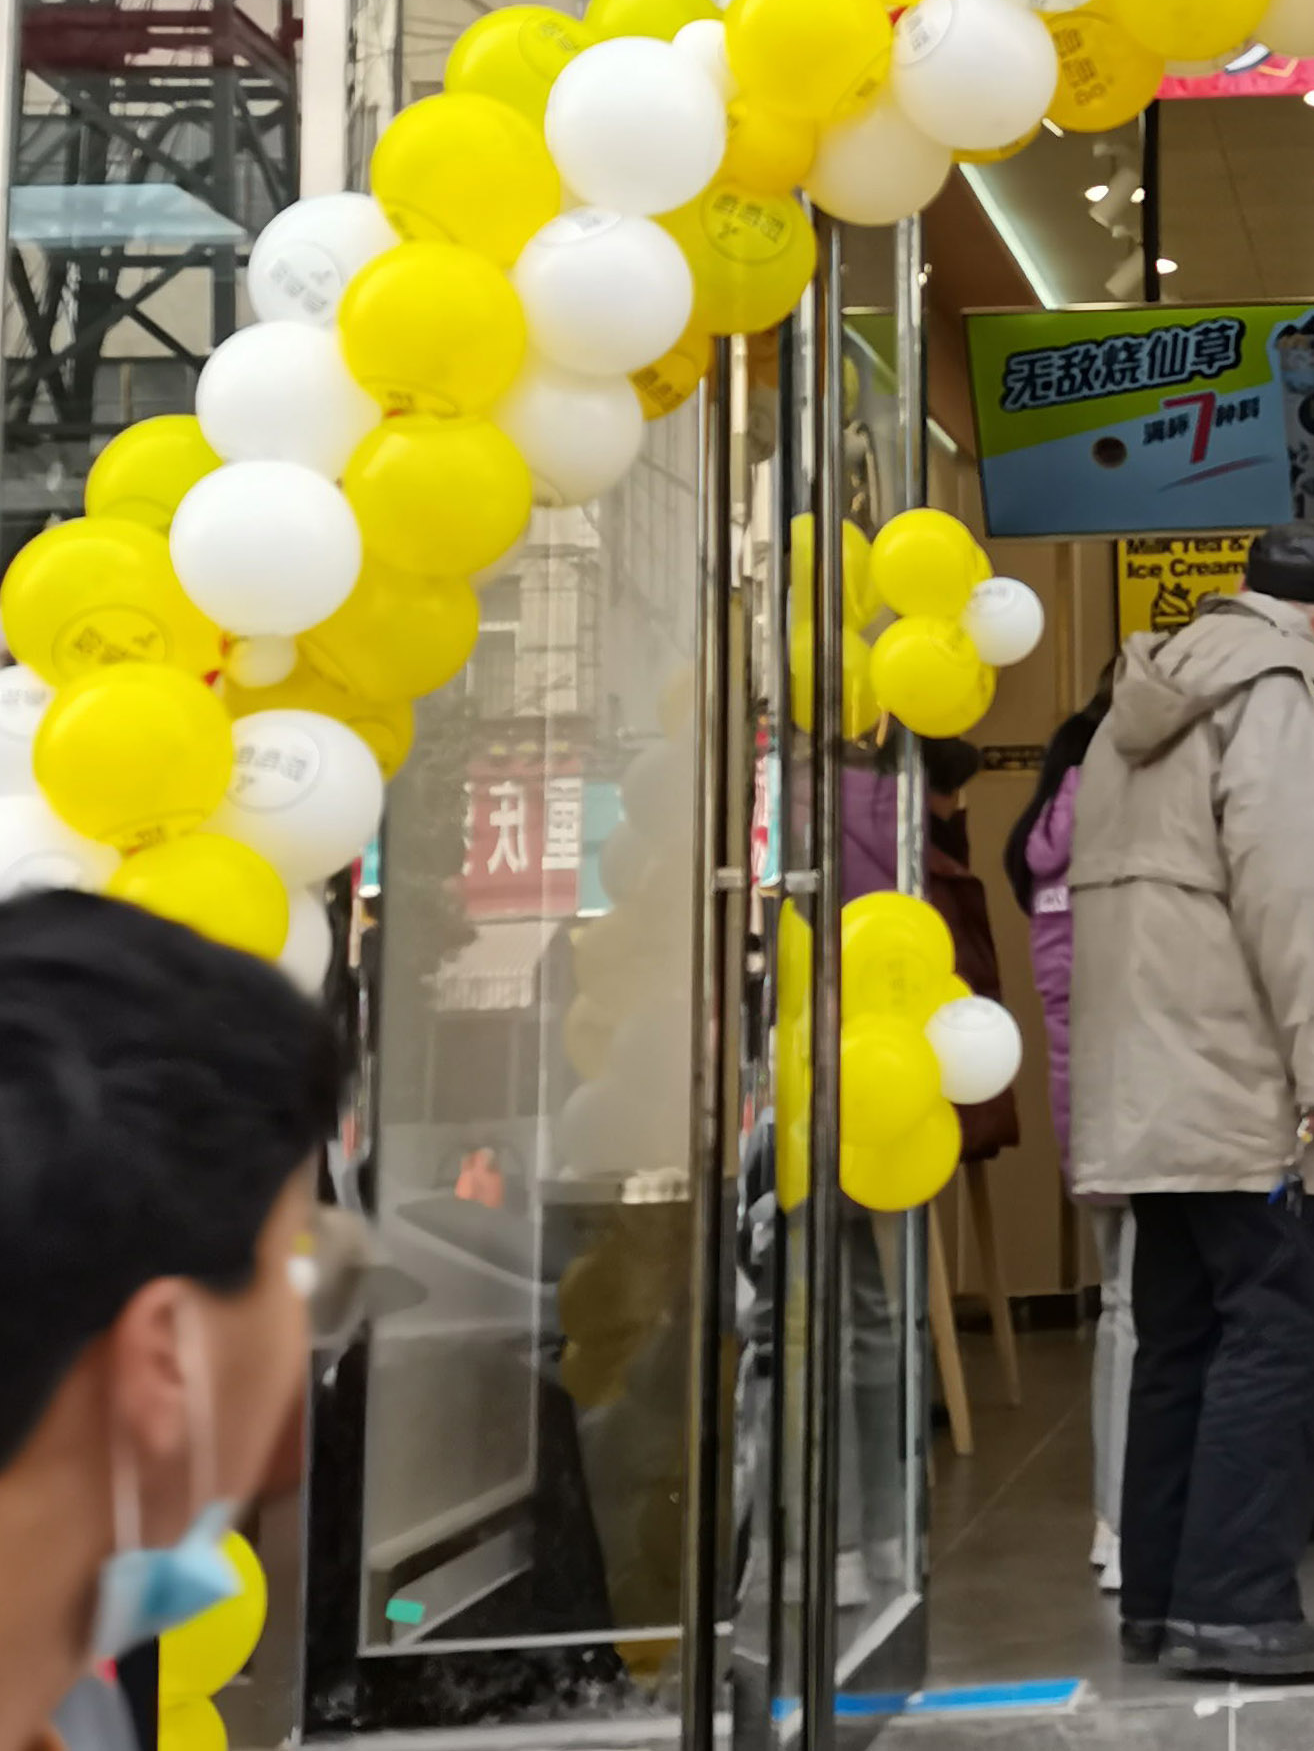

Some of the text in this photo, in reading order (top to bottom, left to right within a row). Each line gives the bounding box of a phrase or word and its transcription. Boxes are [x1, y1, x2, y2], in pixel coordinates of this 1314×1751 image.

[1004, 320, 1243, 408] 无敌烧仙草
[1127, 561, 1164, 579] Ice
